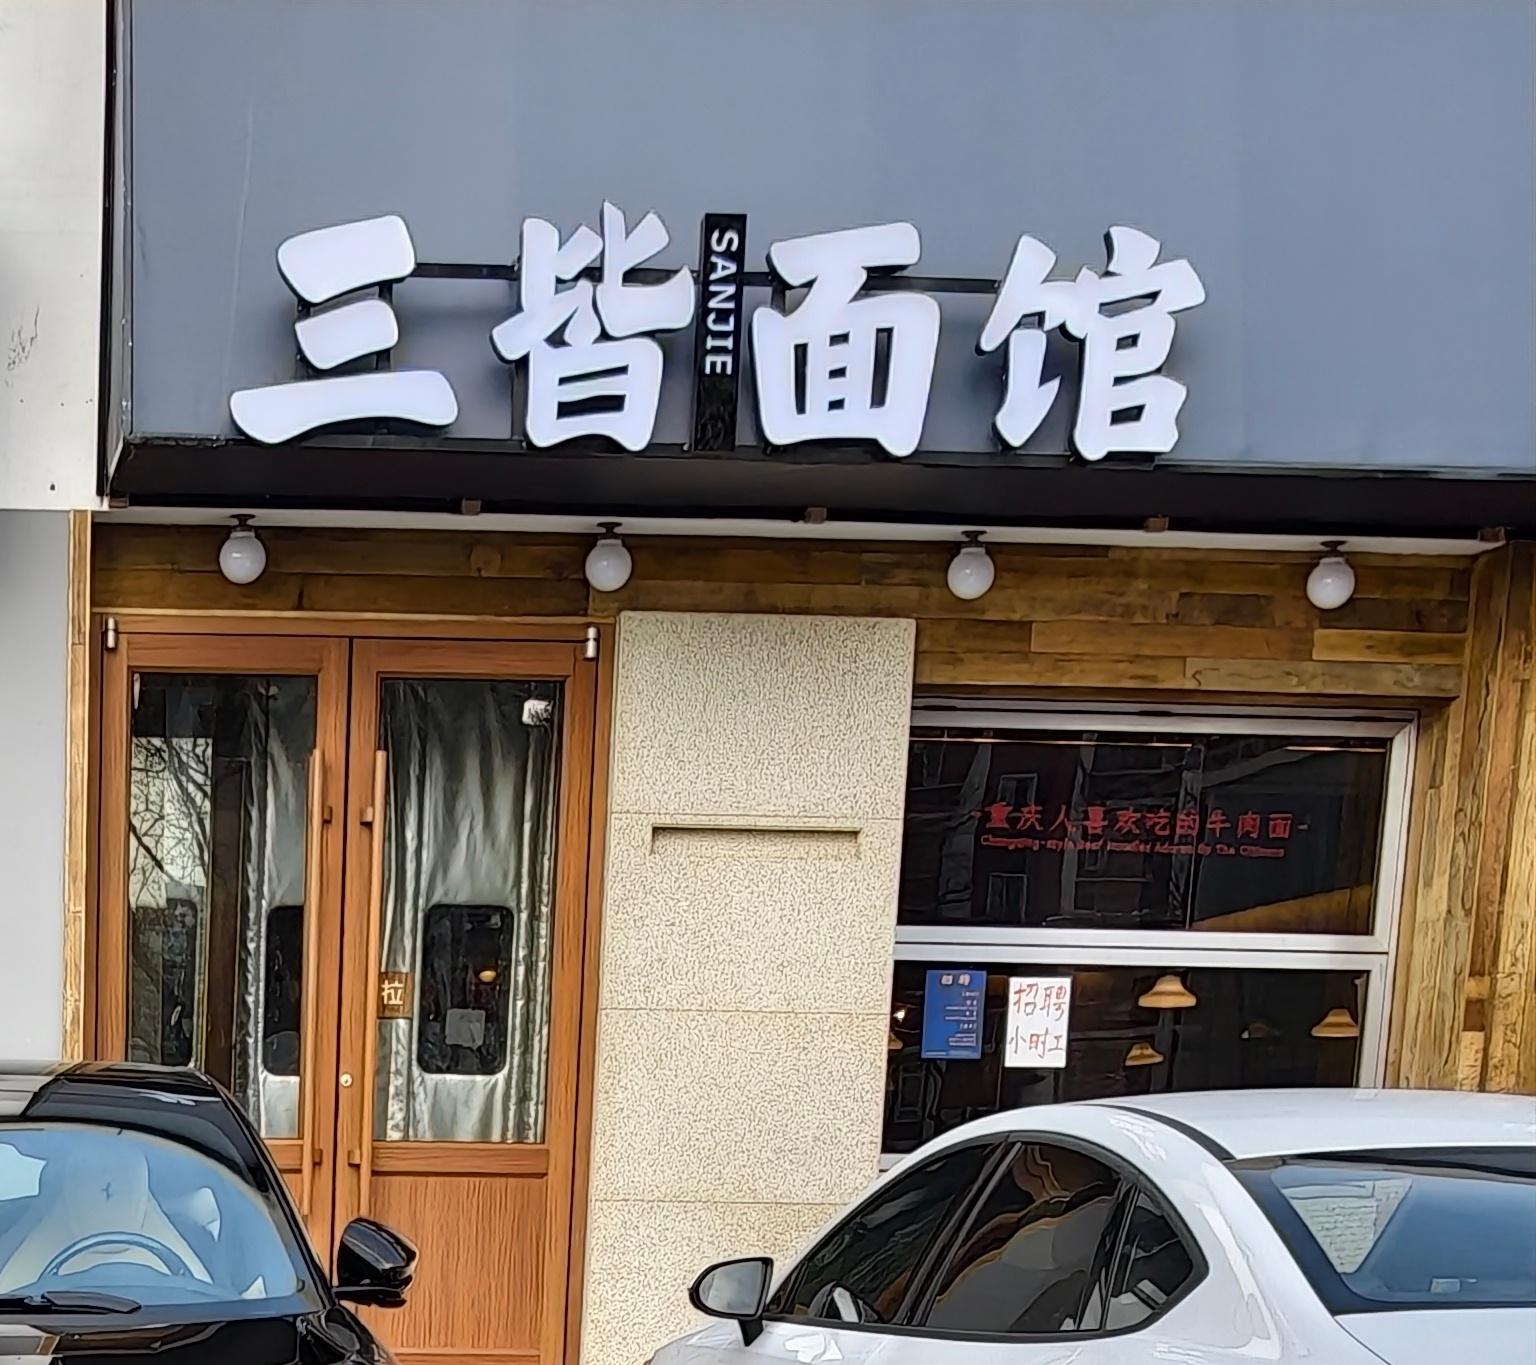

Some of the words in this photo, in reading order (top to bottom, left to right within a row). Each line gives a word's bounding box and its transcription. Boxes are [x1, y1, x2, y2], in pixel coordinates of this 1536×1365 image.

[704, 227, 739, 376] SANJIE
[230, 201, 1206, 462] 三皆面馆
[381, 980, 403, 1005] 拉
[1014, 983, 1067, 1021] 招聘
[1009, 1025, 1065, 1059] 小时工
